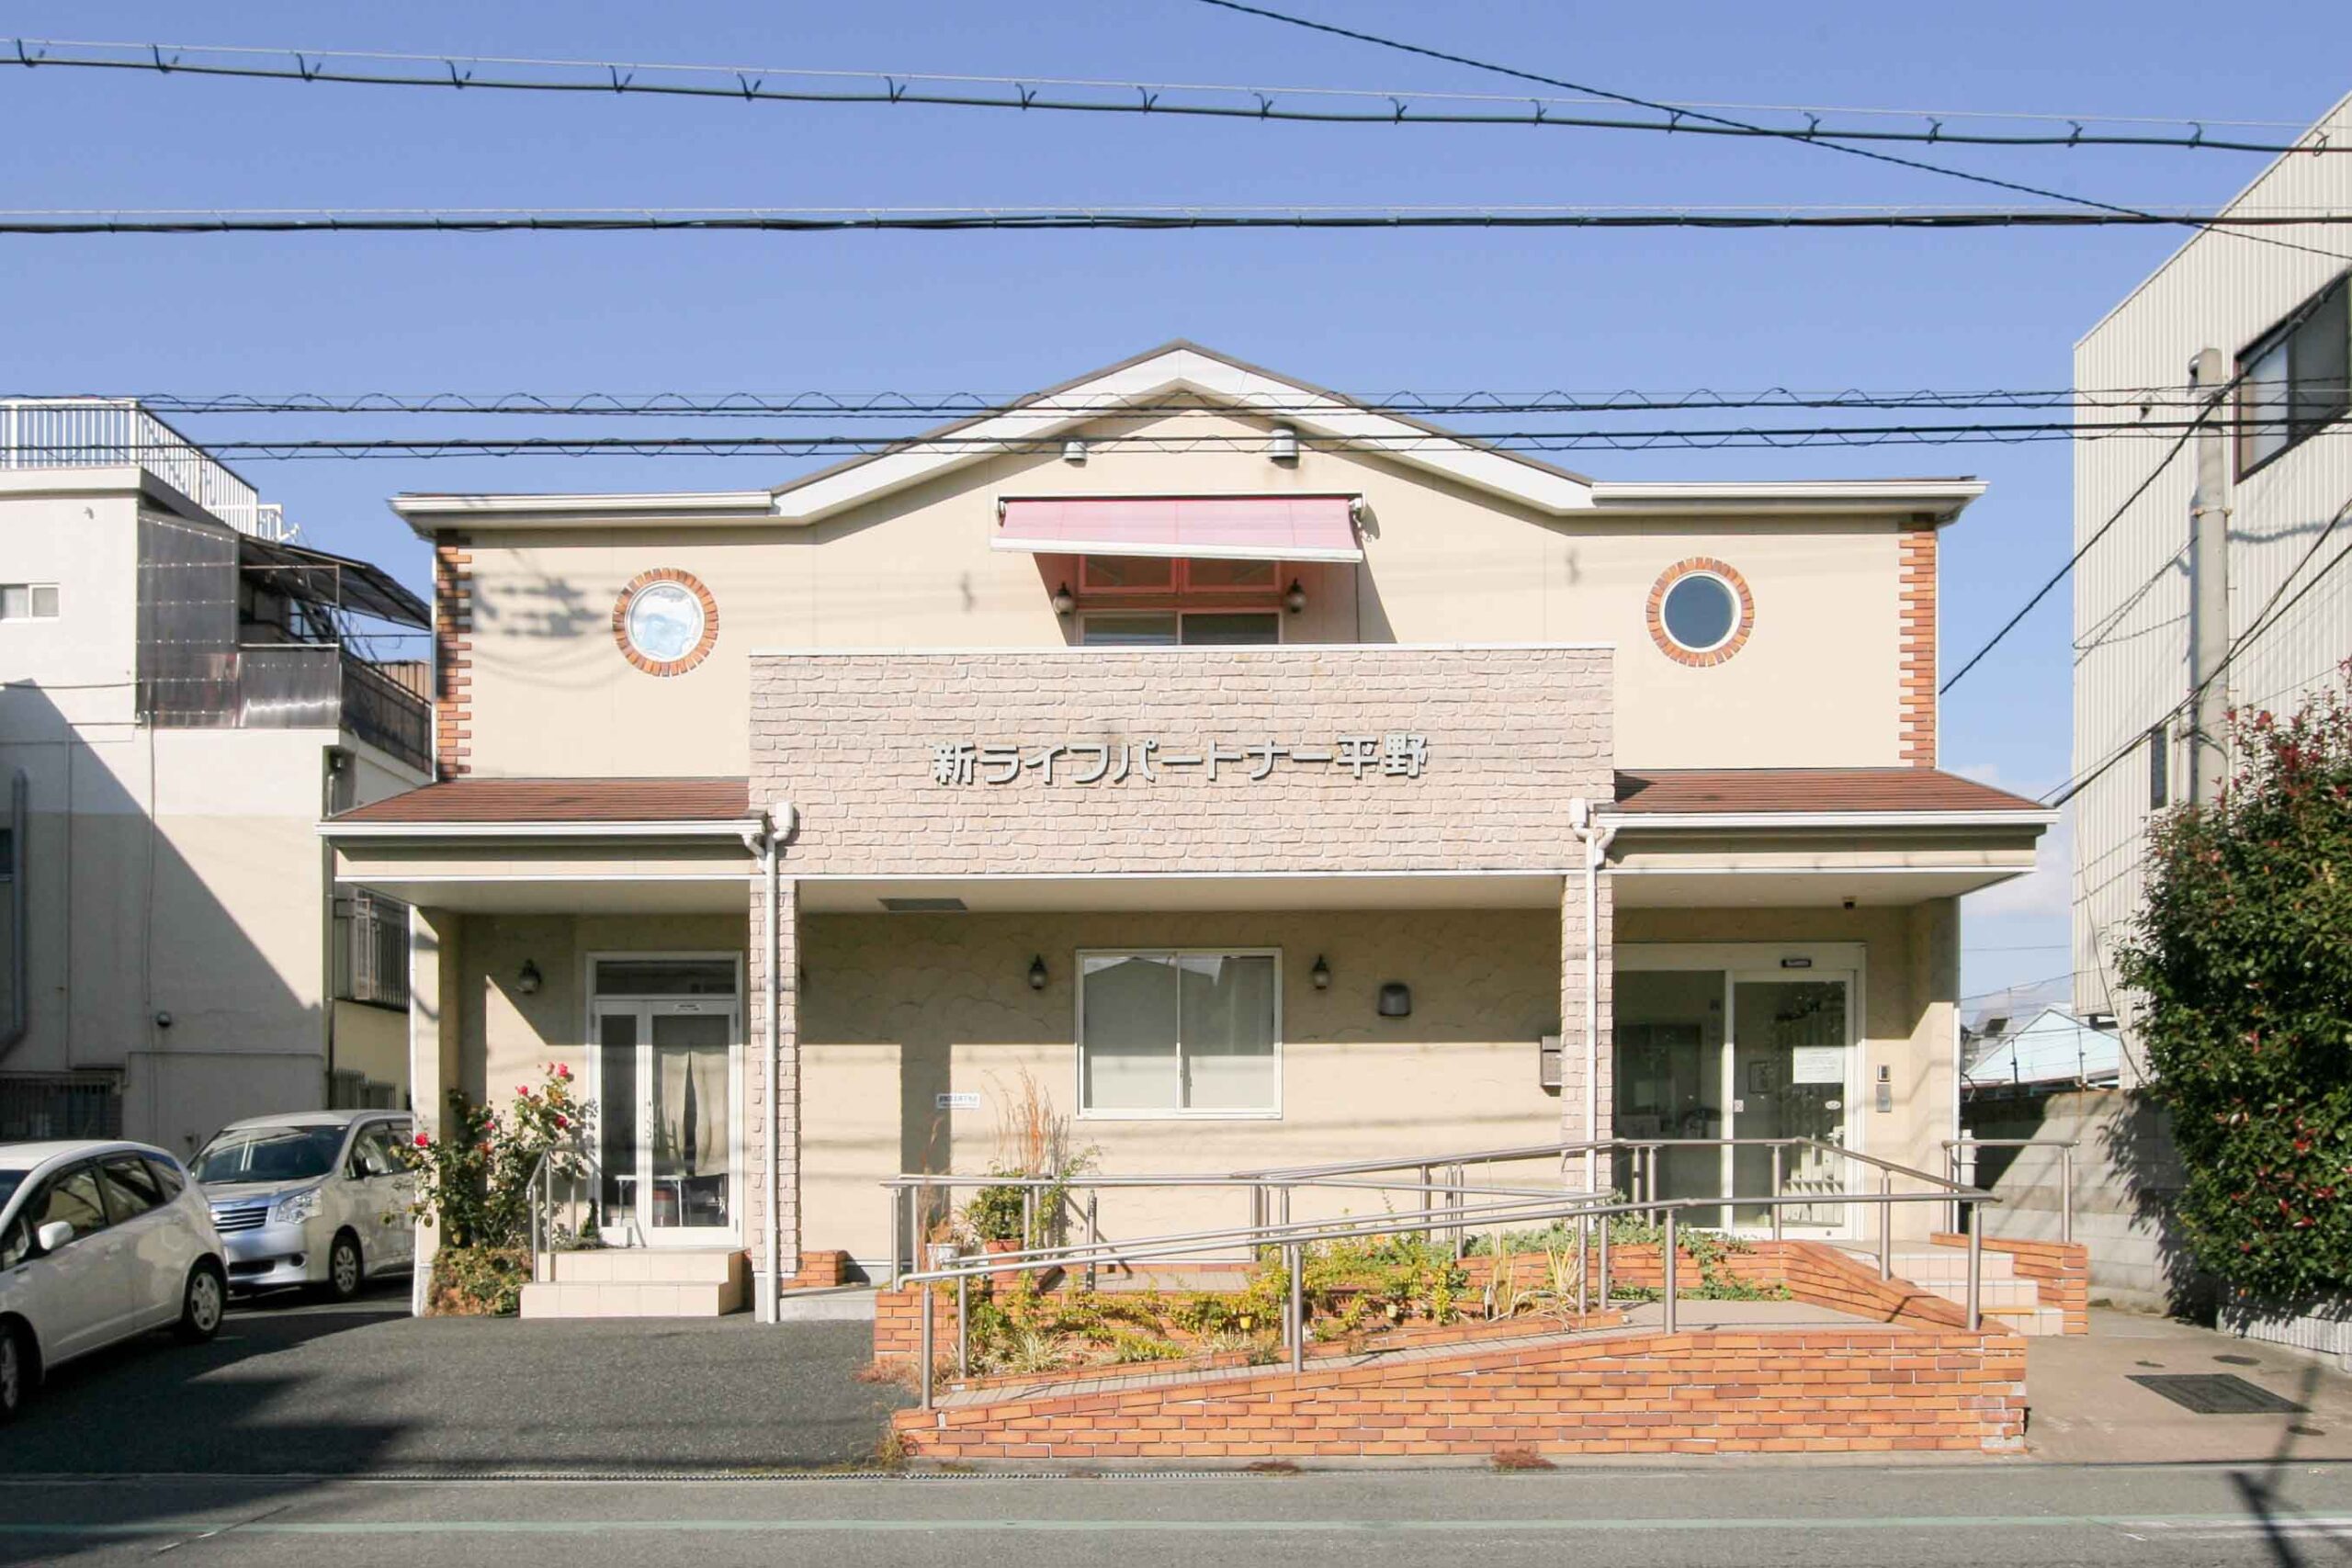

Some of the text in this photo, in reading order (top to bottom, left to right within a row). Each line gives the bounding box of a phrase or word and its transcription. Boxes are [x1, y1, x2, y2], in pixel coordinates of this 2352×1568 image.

[935, 734, 1429, 784] 新ライフパートナー平野
